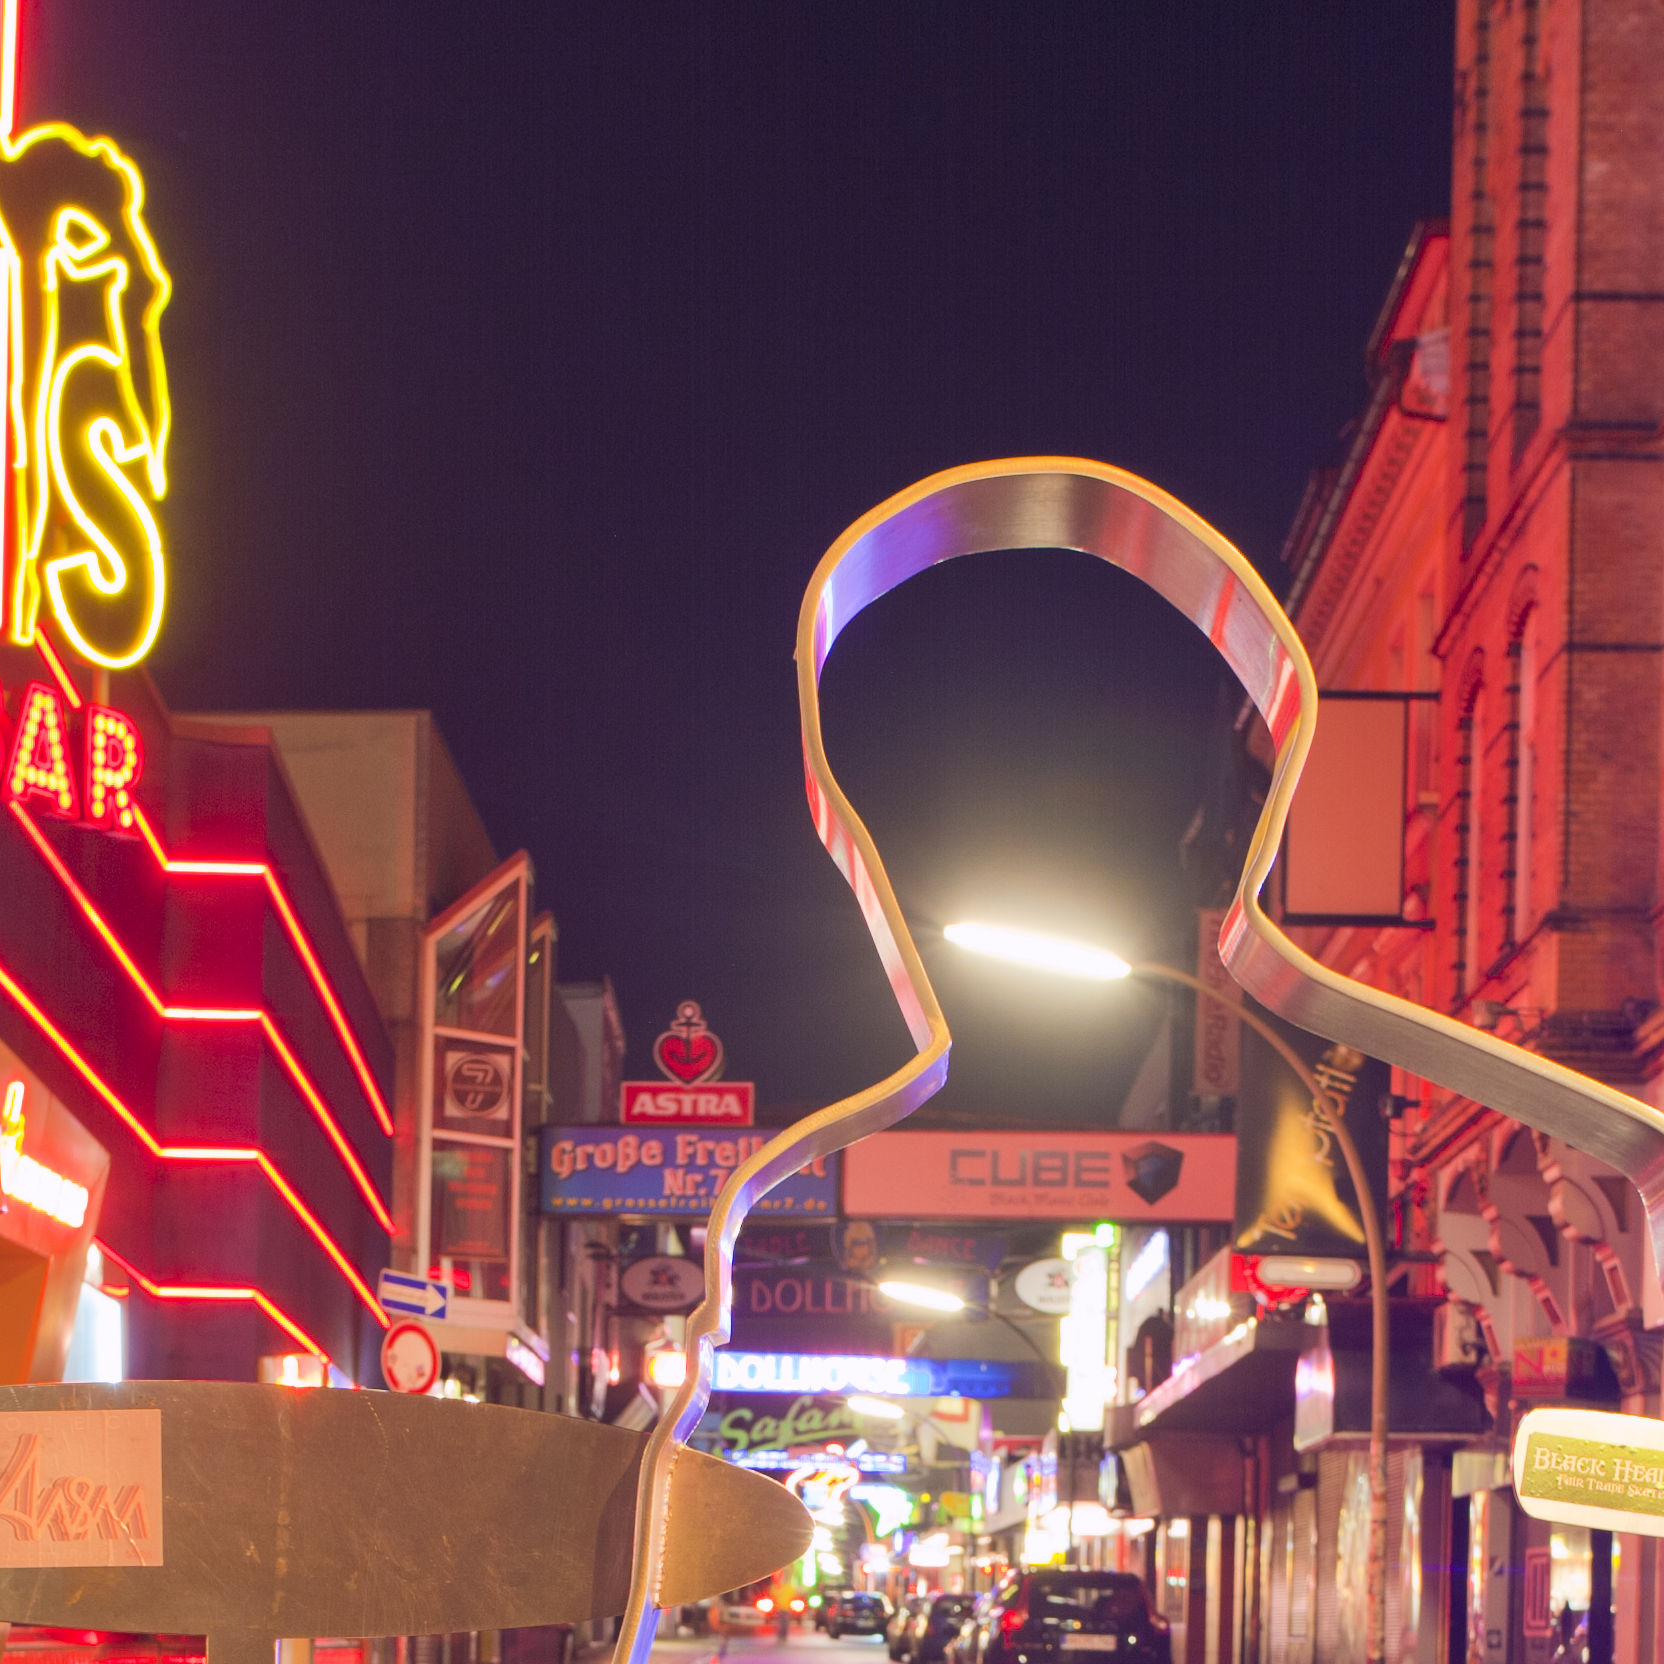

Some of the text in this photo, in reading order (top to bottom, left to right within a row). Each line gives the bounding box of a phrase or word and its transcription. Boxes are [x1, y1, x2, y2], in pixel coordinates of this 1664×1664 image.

[630, 1092, 743, 1117] ASTRA
[550, 1134, 664, 1180] Große
[949, 1148, 1111, 1189] CUBE
[1532, 1446, 1607, 1477] BLACK
